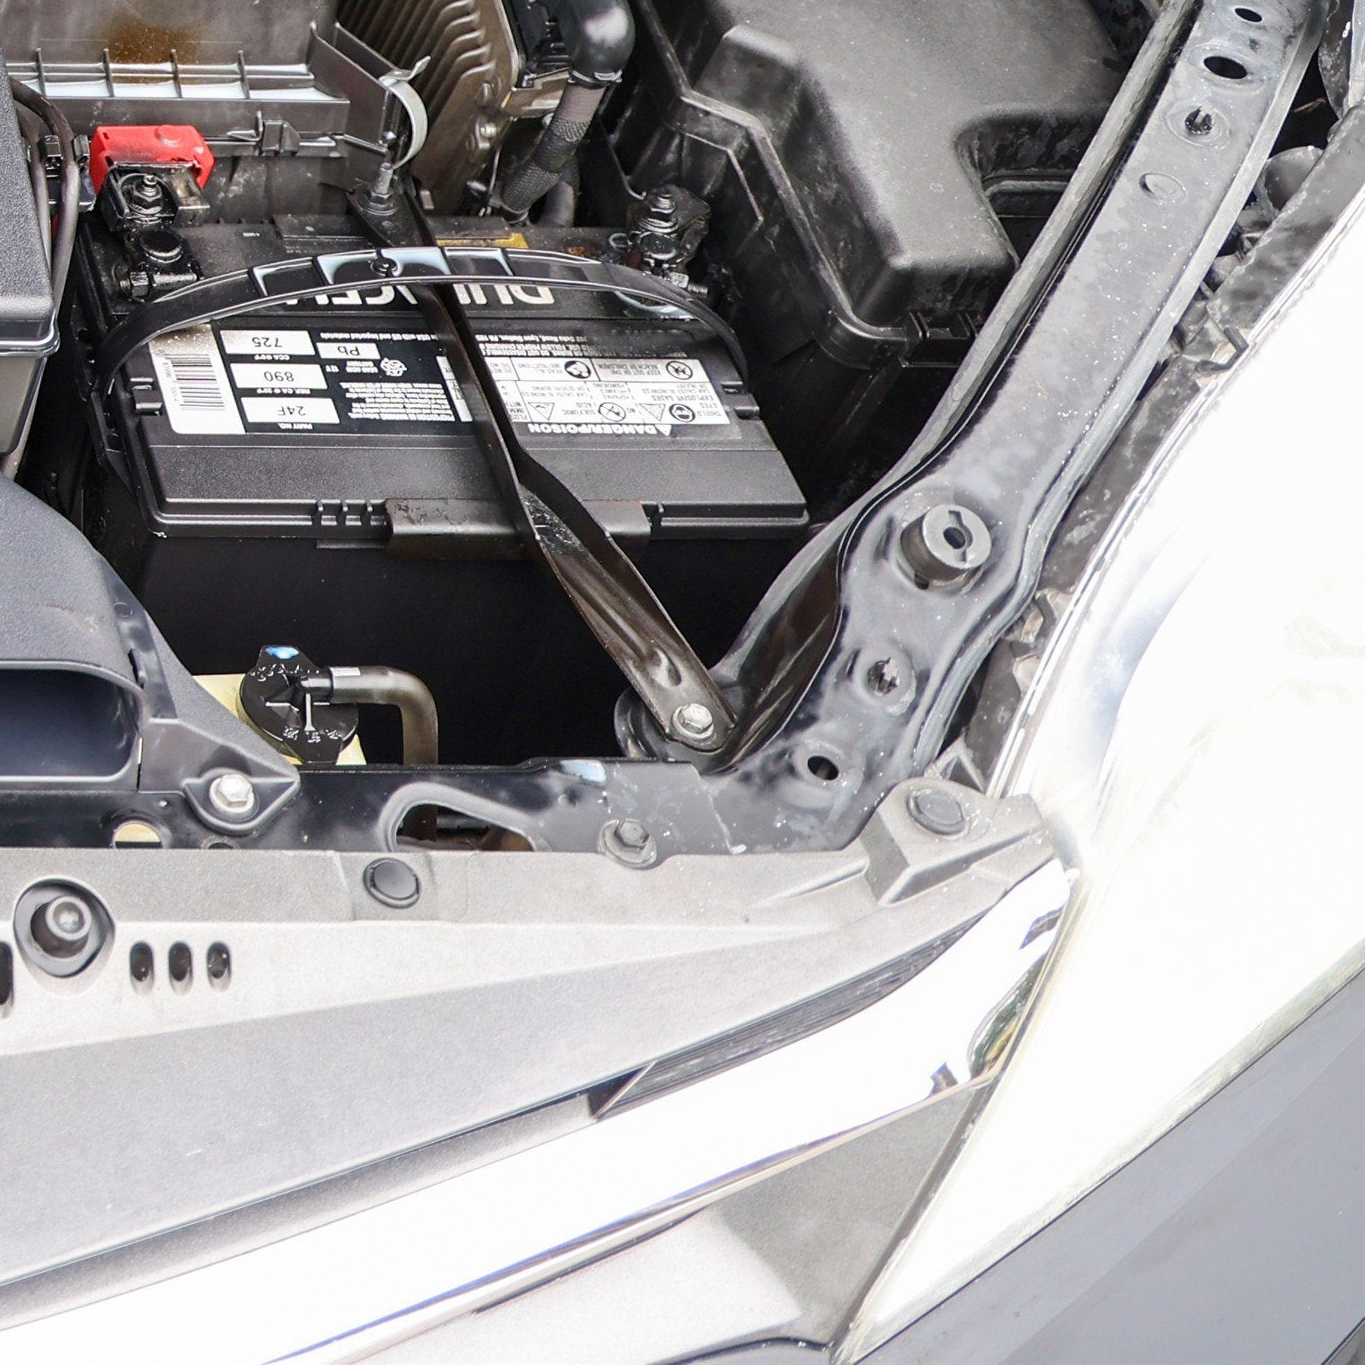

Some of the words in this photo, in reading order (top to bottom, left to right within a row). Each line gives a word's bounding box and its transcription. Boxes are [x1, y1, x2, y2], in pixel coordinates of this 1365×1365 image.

[251, 337, 283, 348] 725
[337, 346, 360, 356] Pb
[263, 371, 295, 382] 890
[276, 406, 306, 416] 24F
